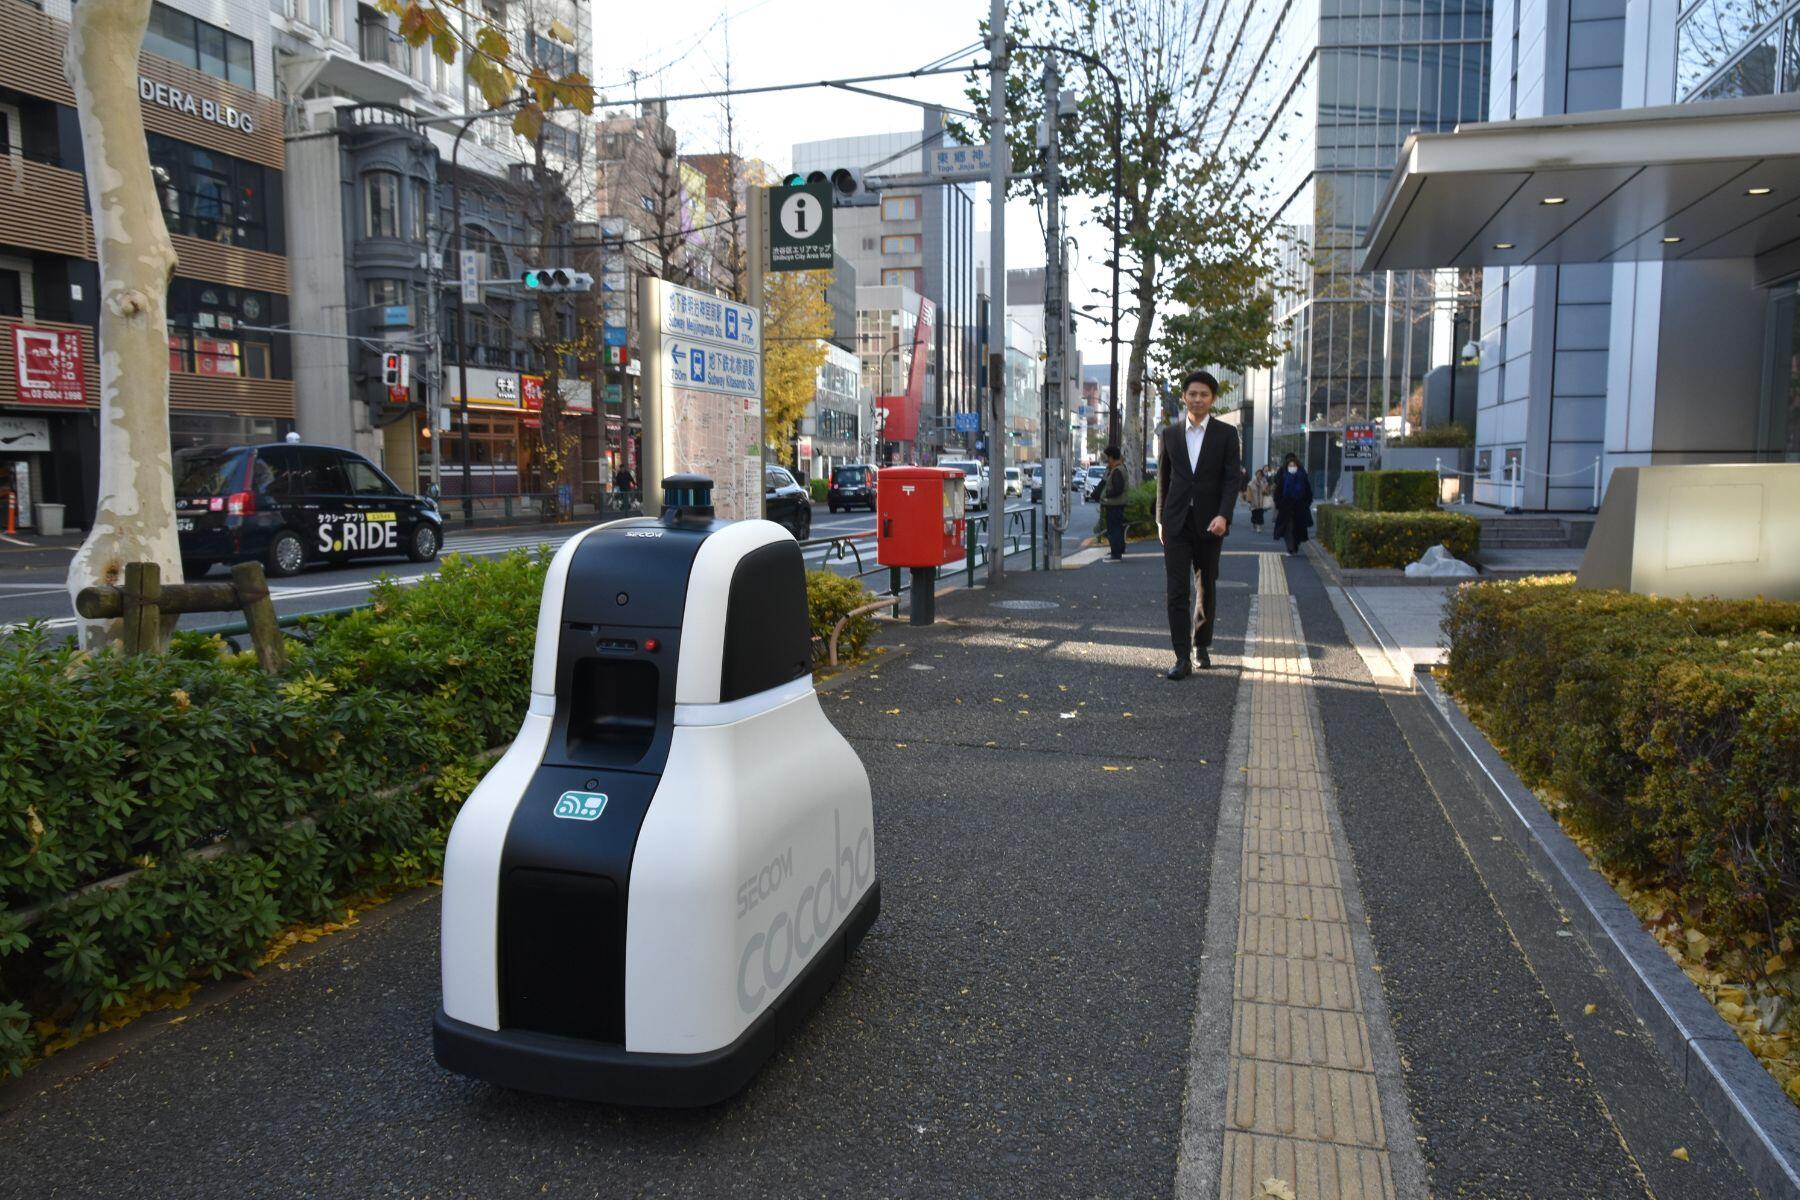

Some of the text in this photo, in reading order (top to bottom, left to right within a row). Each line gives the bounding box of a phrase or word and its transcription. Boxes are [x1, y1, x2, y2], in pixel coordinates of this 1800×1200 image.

[202, 98, 254, 133] BLDG
[937, 149, 991, 165] 東郷神
[772, 243, 831, 255] 渋谷区エリアマップ
[772, 254, 794, 262] Shibuya
[795, 253, 806, 261] City
[669, 292, 722, 322] 地下鉄明治神宮前駅
[669, 313, 685, 332] Subway
[709, 350, 755, 377] 地下鉄北参道駅
[497, 378, 515, 392] 牛丼
[707, 371, 725, 388] Subway
[318, 513, 365, 523] タクシーアプリ
[318, 521, 397, 553] S.RIDE
[737, 846, 793, 920] SECOM
[737, 808, 872, 1014] cocobo
